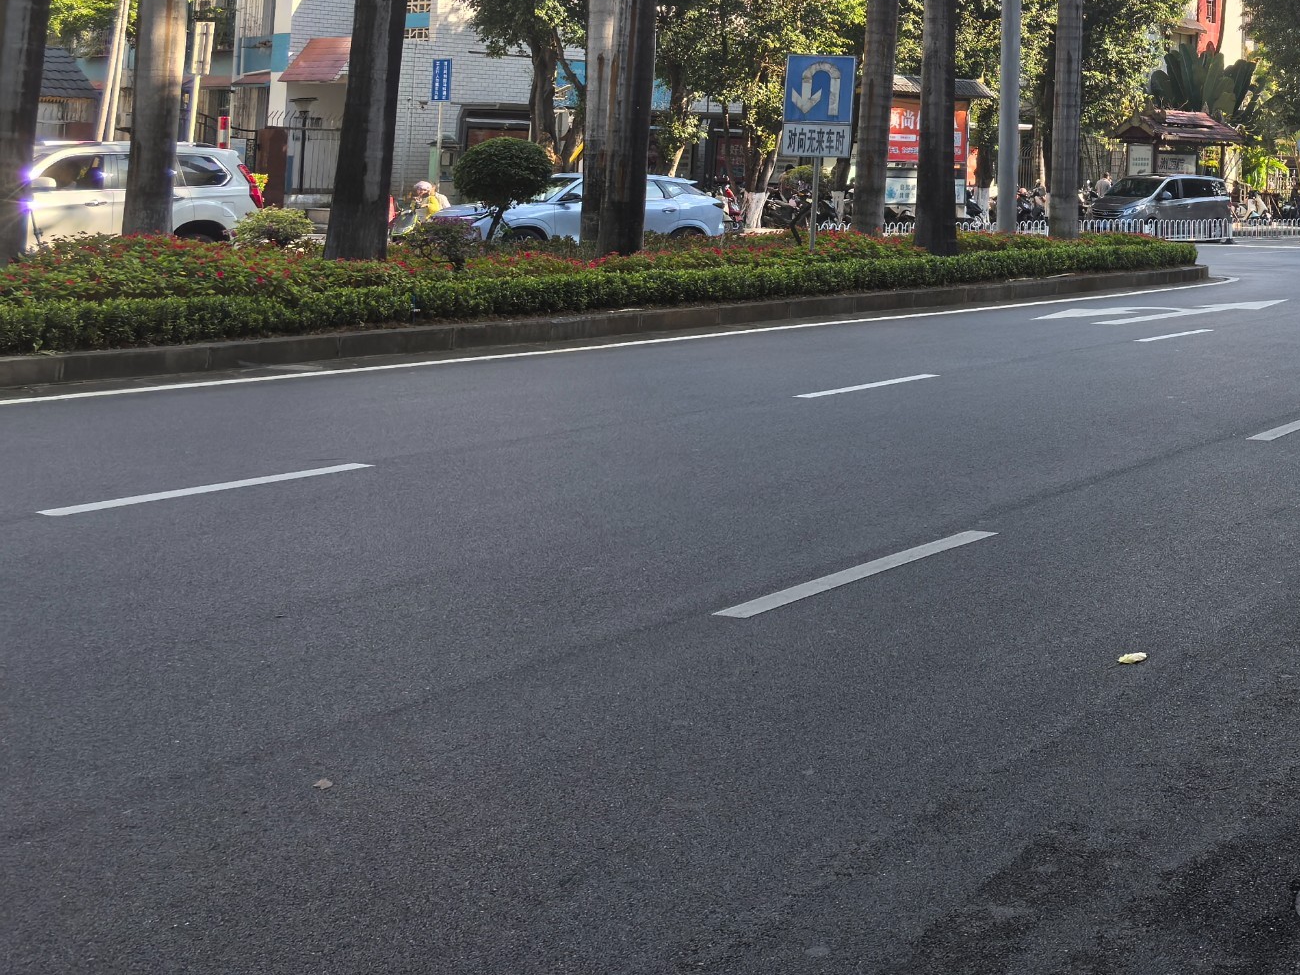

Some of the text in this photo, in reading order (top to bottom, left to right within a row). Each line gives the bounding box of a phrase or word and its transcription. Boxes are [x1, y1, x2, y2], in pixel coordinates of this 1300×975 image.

[786, 127, 846, 155] 对向无来车时
